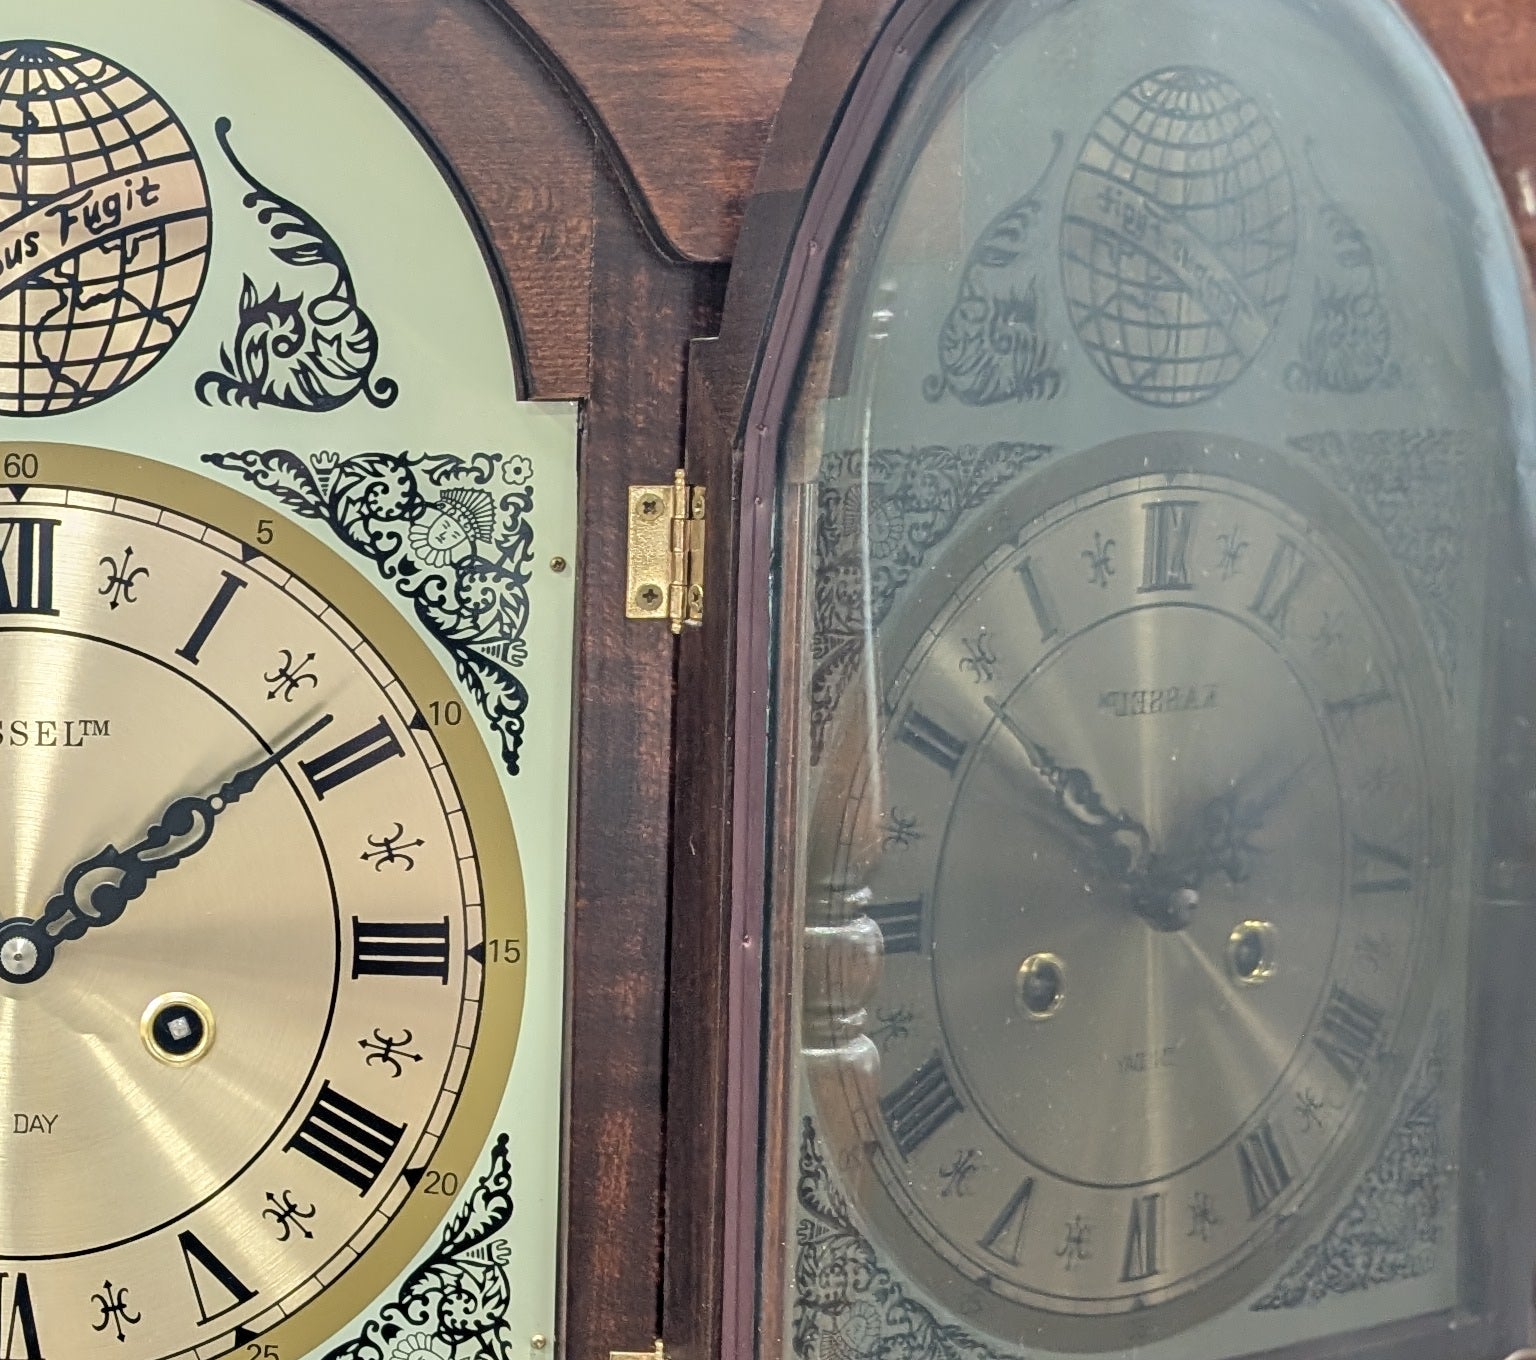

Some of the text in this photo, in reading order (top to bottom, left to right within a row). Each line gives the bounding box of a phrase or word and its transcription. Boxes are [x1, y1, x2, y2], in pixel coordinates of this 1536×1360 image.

[44, 175, 162, 248] Fugit
[2, 452, 40, 480] 60
[255, 519, 276, 545] 5
[174, 569, 249, 666] I
[428, 700, 462, 725] 10
[296, 714, 407, 802] II
[351, 914, 451, 986] III
[489, 939, 522, 964] 15
[13, 1113, 60, 1135] DAY
[281, 1079, 409, 1198] IIII
[424, 1172, 458, 1197] 20
[177, 1229, 260, 1327] V
